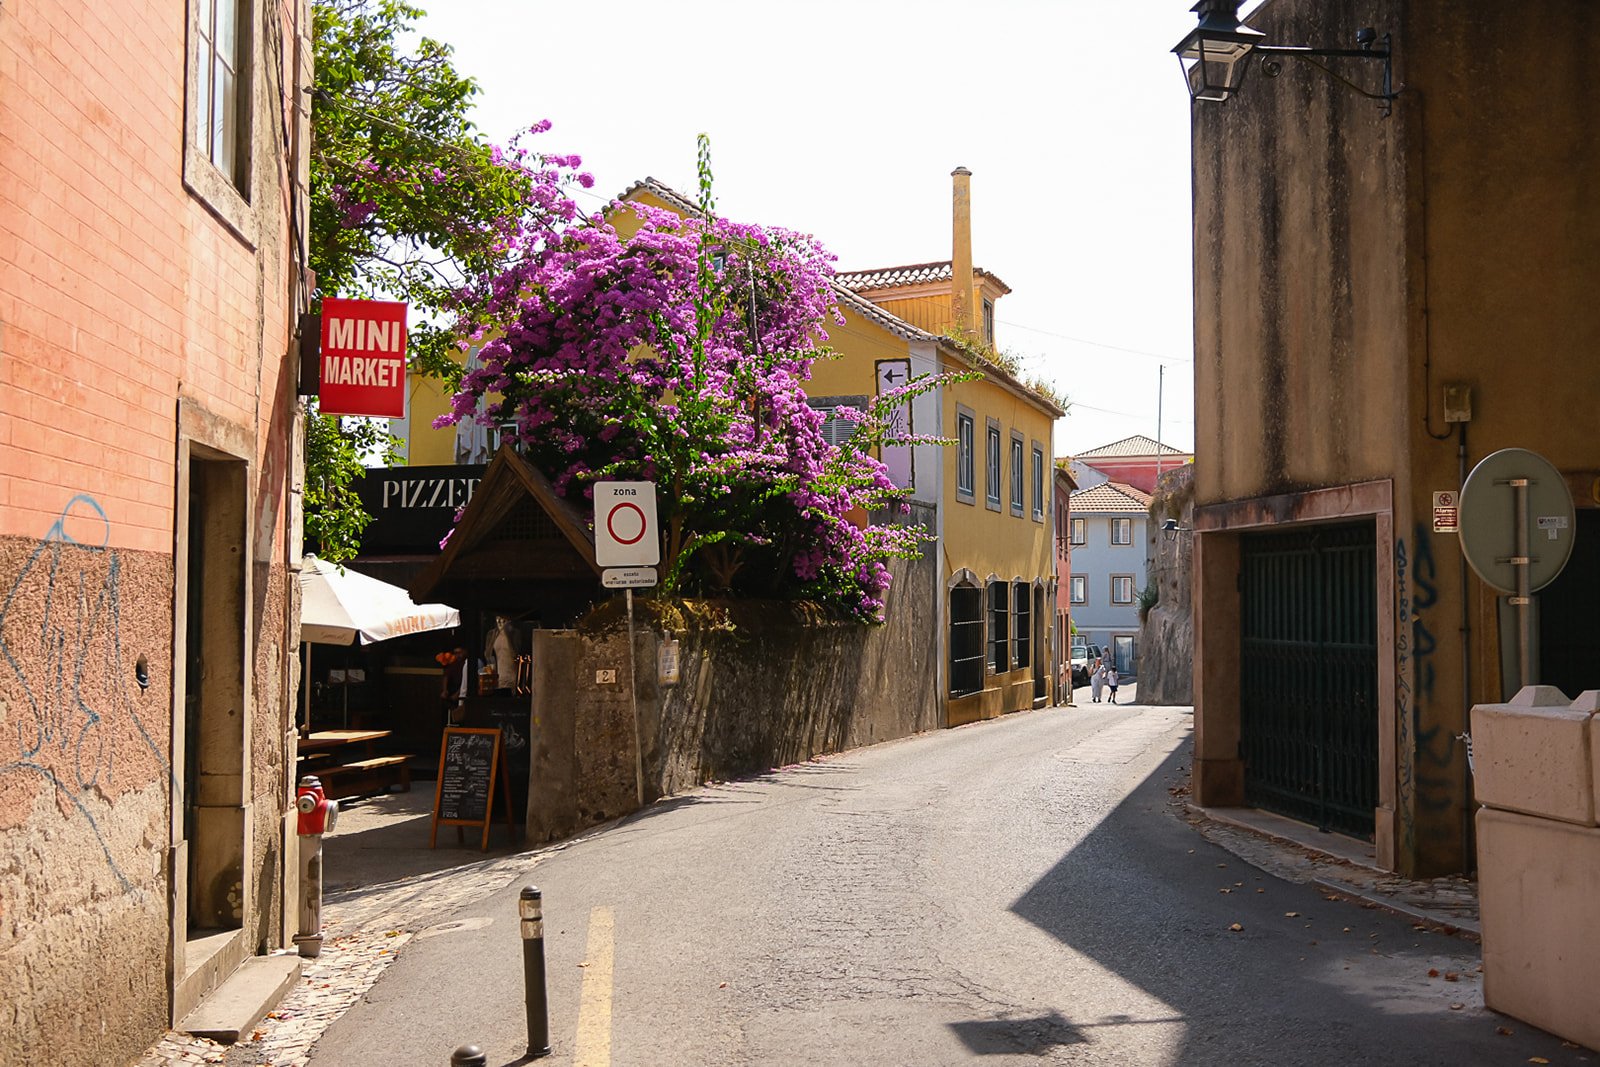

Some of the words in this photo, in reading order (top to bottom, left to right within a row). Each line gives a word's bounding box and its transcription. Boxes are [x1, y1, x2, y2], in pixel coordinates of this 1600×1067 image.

[328, 318, 400, 352] MINI
[324, 356, 401, 387] MARKET
[613, 488, 637, 496] zona
[602, 670, 609, 682] 2
